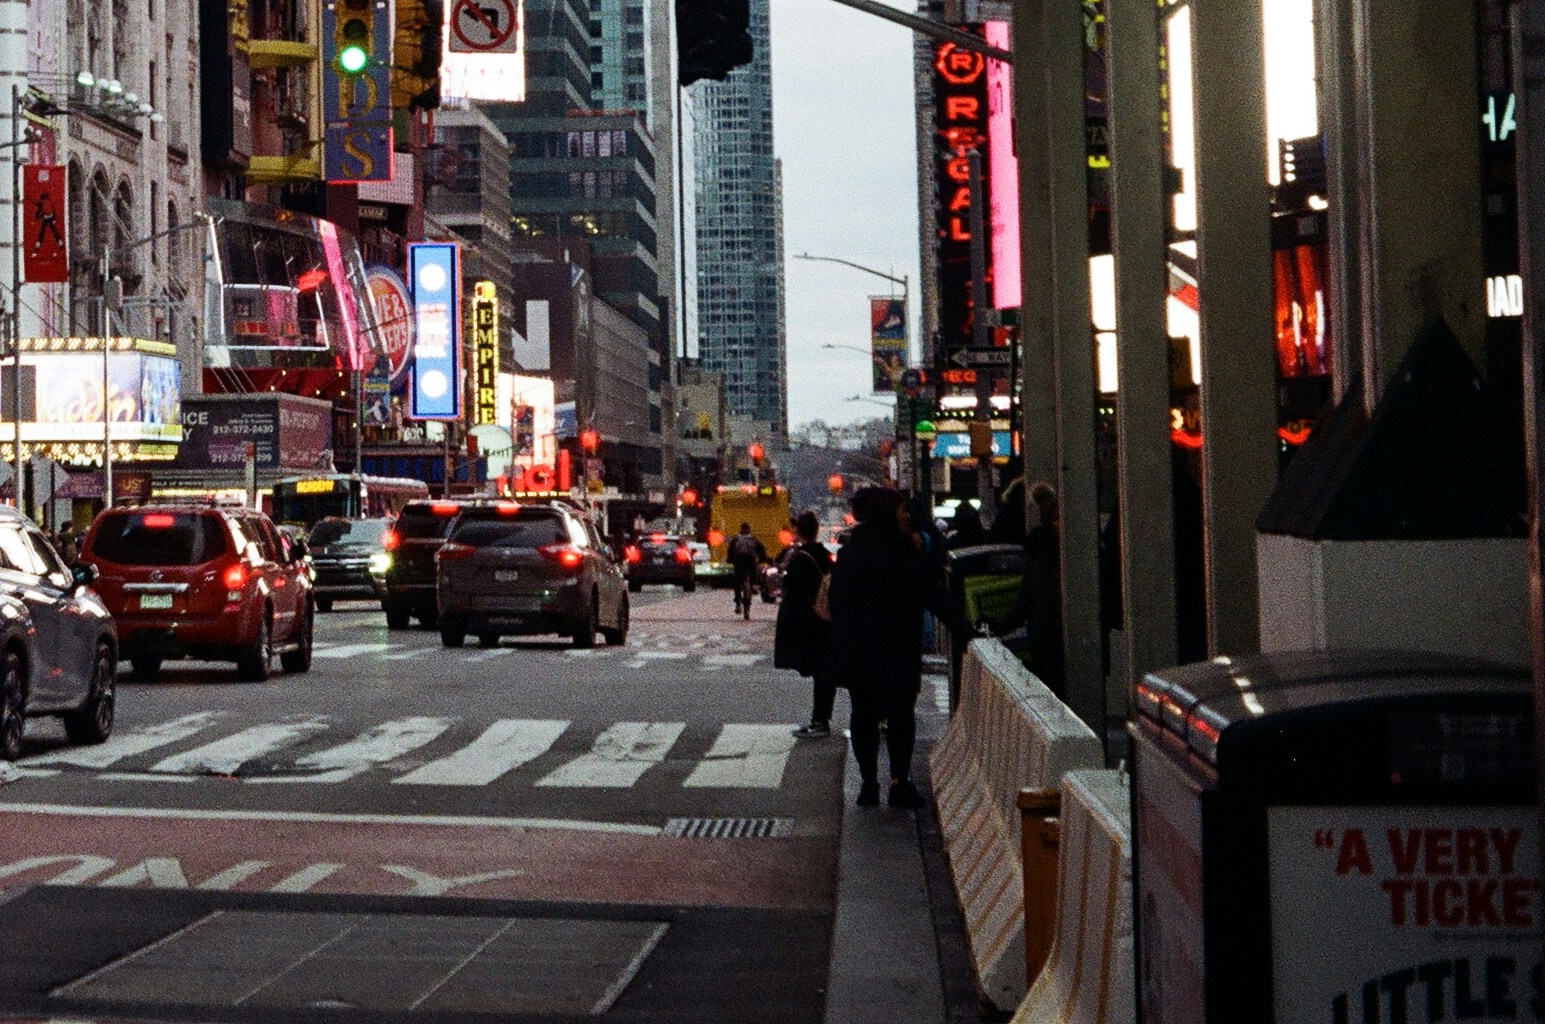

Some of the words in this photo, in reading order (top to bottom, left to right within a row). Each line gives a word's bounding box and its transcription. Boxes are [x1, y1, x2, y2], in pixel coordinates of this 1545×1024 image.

[478, 307, 496, 425] EMPIRE
[182, 412, 209, 426] ICE
[1387, 828, 1523, 875] VERY
